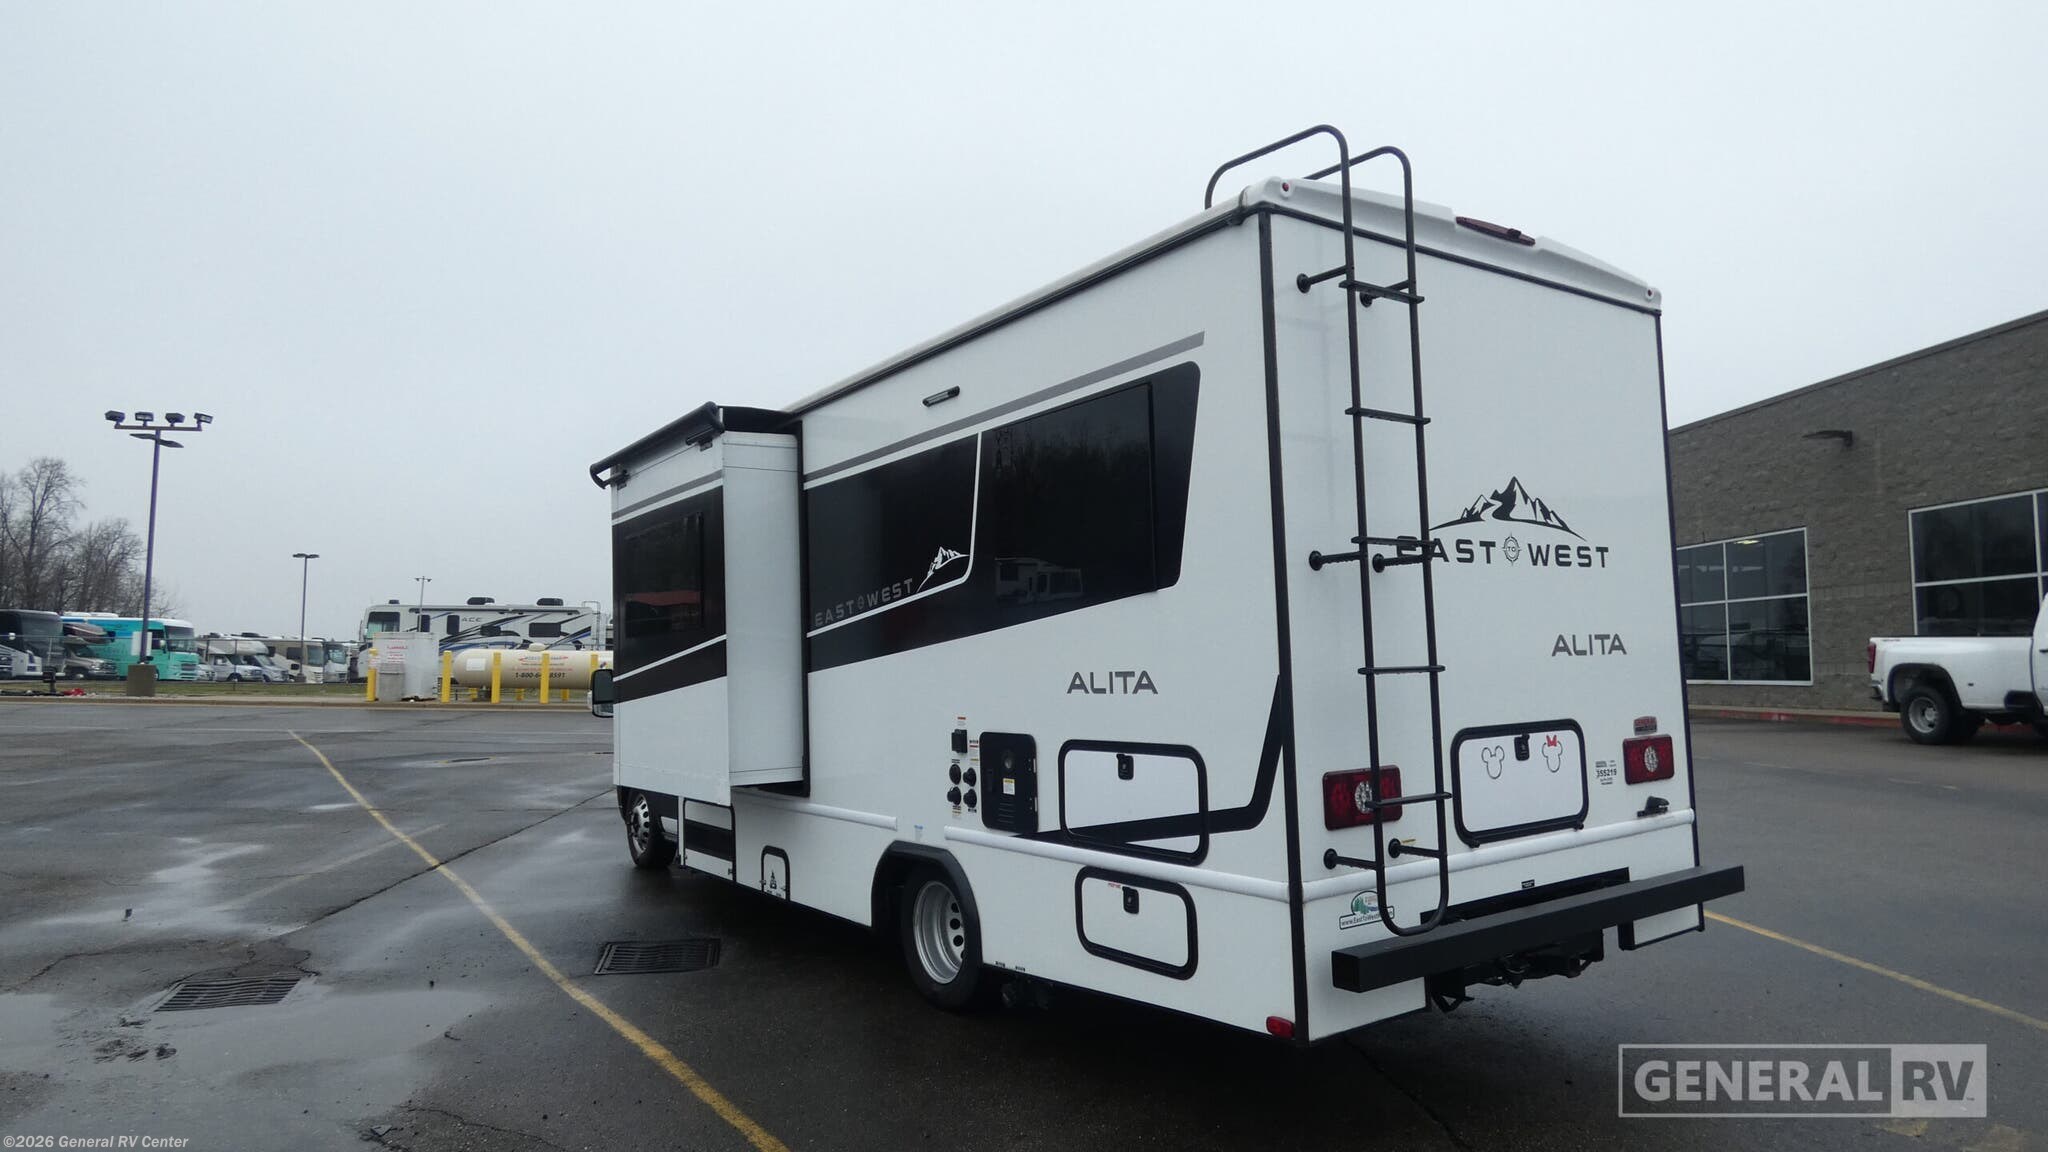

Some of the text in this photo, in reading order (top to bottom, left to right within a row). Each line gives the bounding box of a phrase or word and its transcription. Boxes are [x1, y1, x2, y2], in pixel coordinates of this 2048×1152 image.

[1396, 535, 1496, 564] EAST
[1528, 543, 1609, 568] WEST
[815, 578, 913, 627] EAST WEST
[1552, 634, 1627, 656] ALITA
[1066, 670, 1158, 694] ALITA
